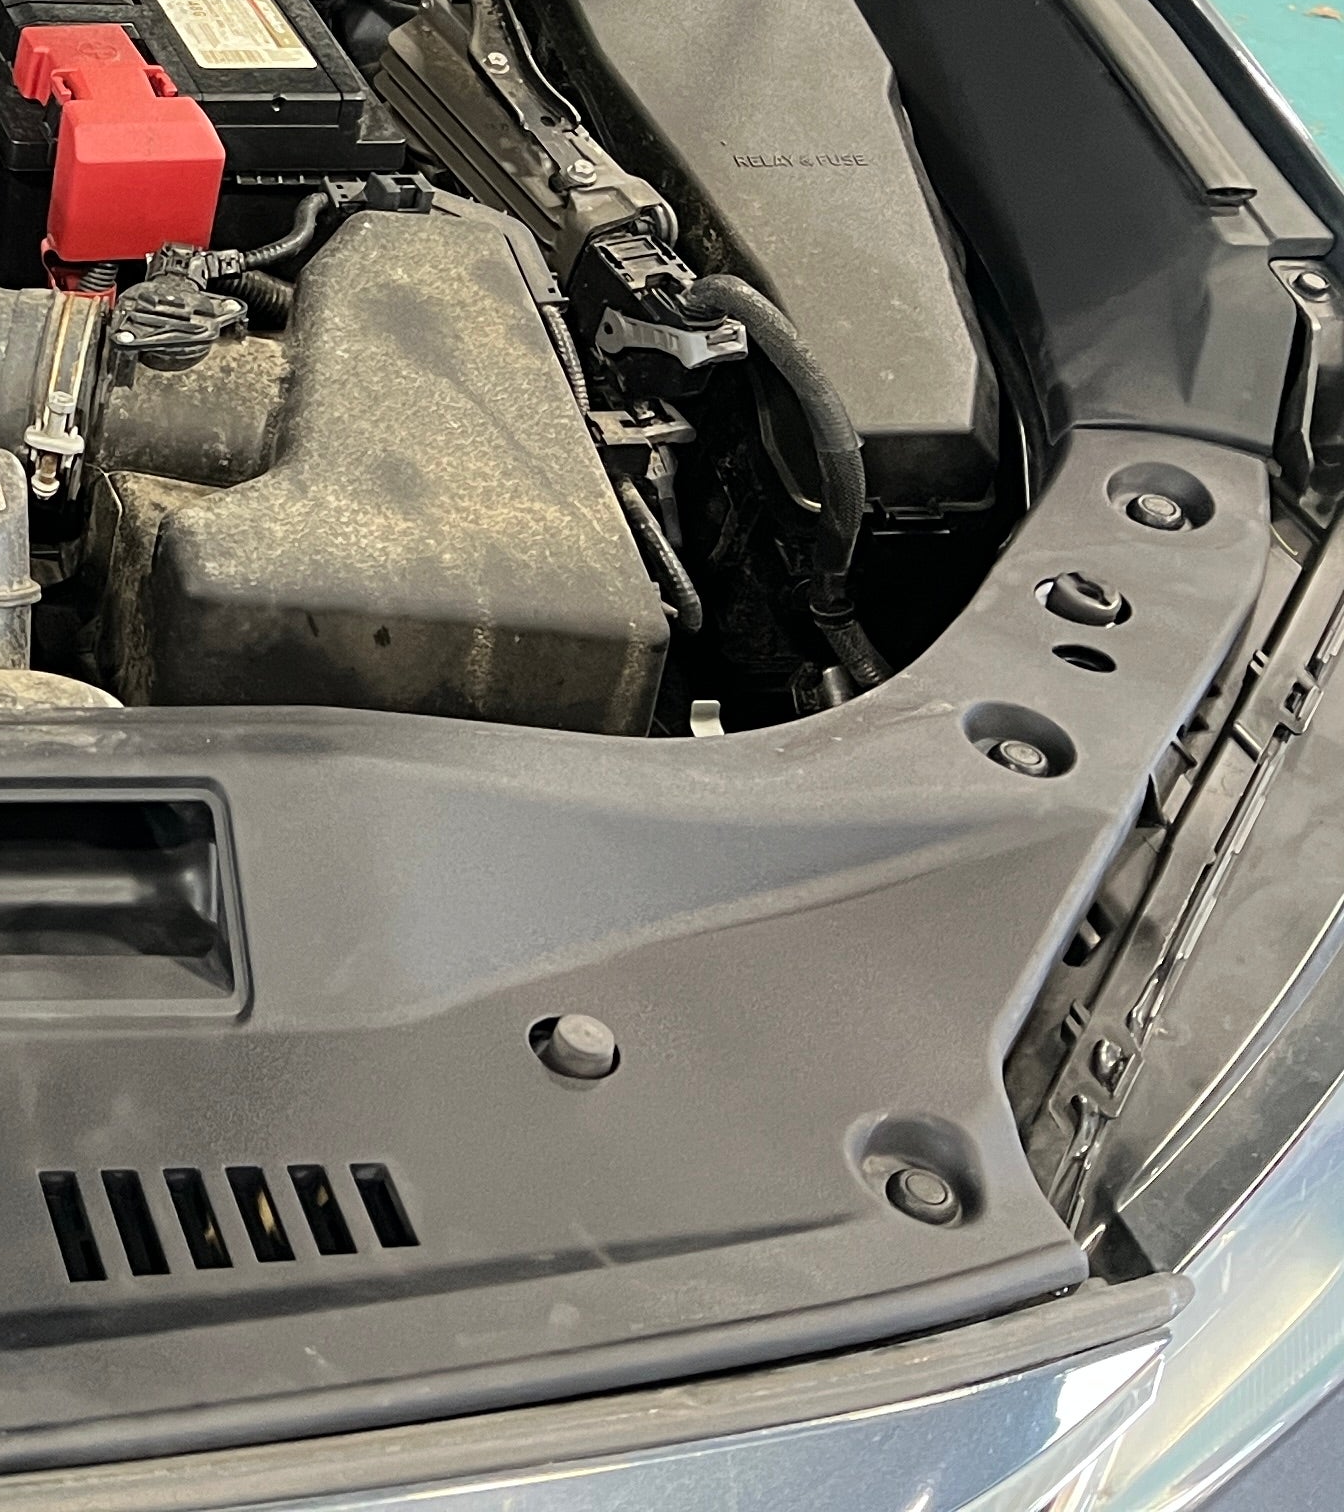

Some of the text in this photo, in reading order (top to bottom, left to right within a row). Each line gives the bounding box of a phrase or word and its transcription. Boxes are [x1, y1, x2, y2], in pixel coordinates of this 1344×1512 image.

[732, 153, 870, 169] RELAY & FUSE
